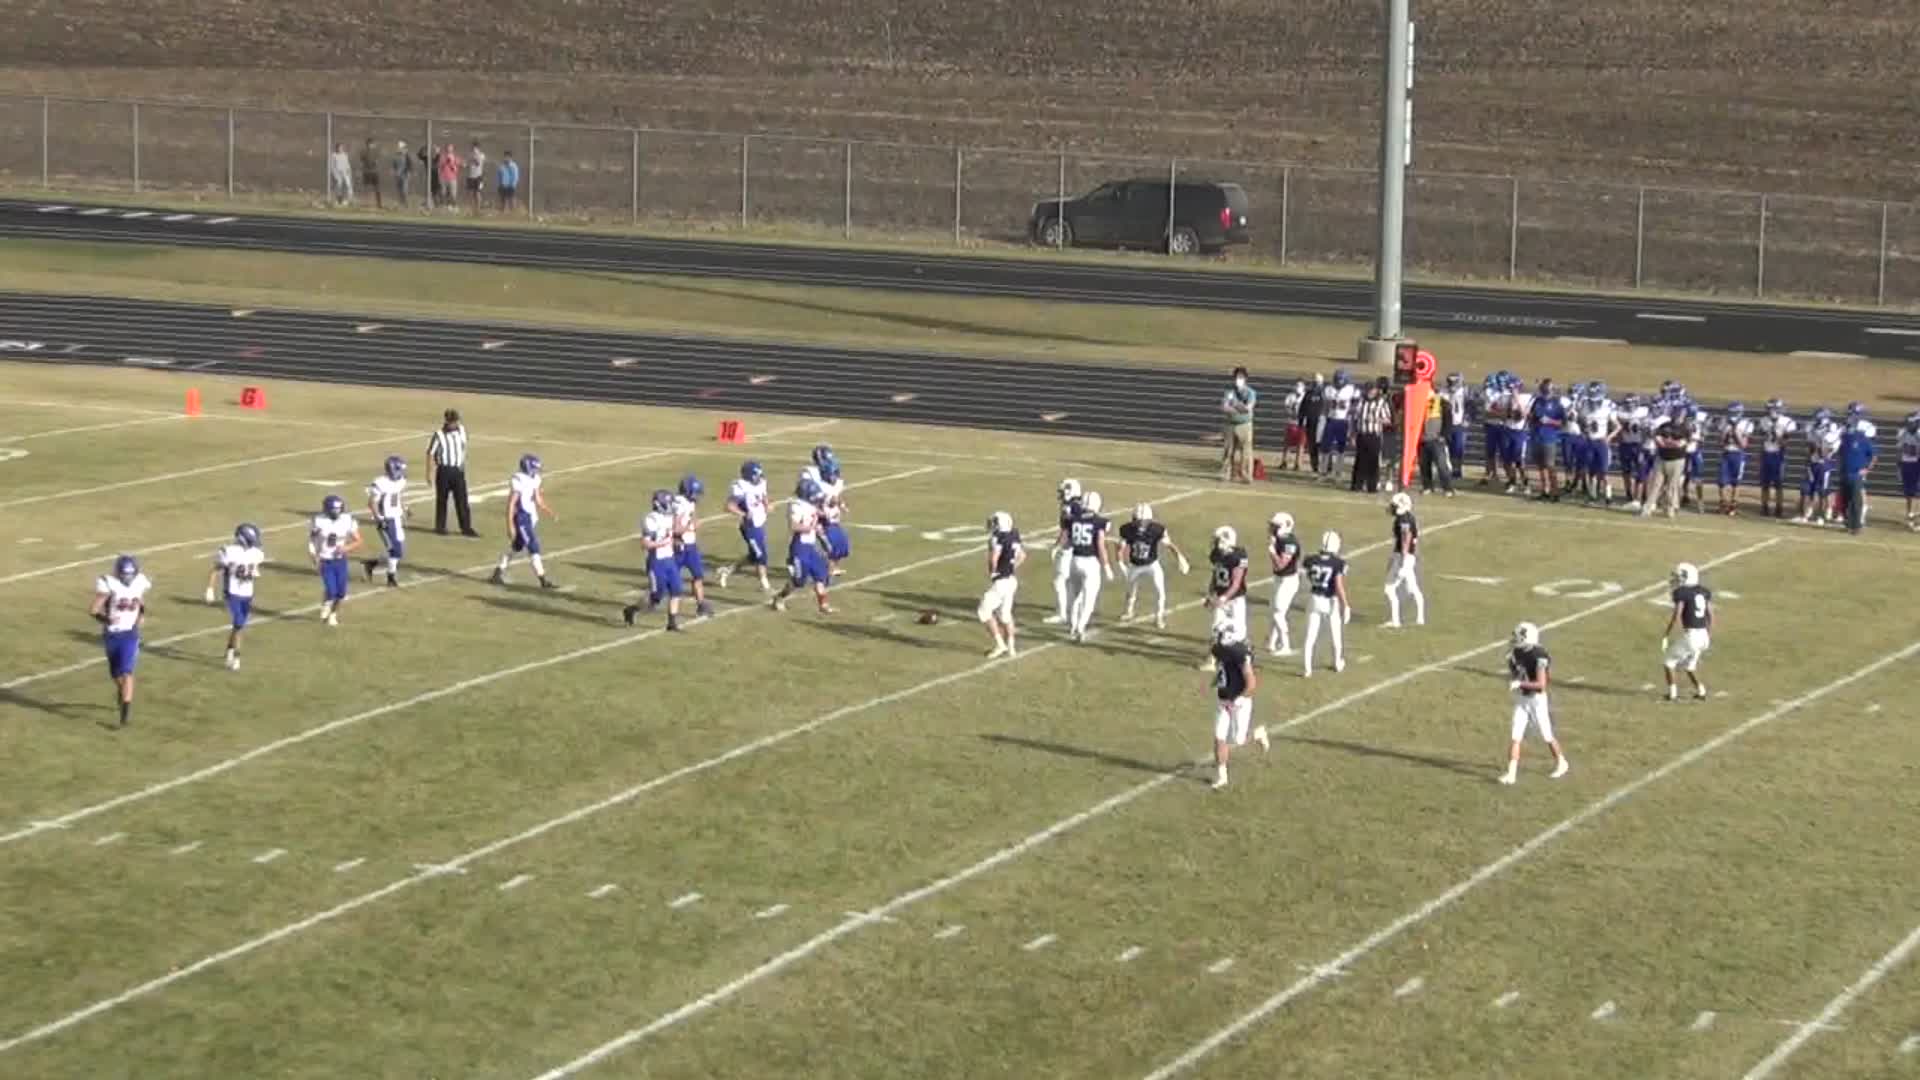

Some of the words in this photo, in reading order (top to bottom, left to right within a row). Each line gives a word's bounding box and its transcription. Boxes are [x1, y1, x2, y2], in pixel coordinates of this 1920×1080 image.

[241, 387, 257, 406] G
[721, 421, 738, 440] 10
[1072, 522, 1094, 546] 85
[1311, 565, 1333, 588] 27
[1694, 594, 1706, 618] 9
